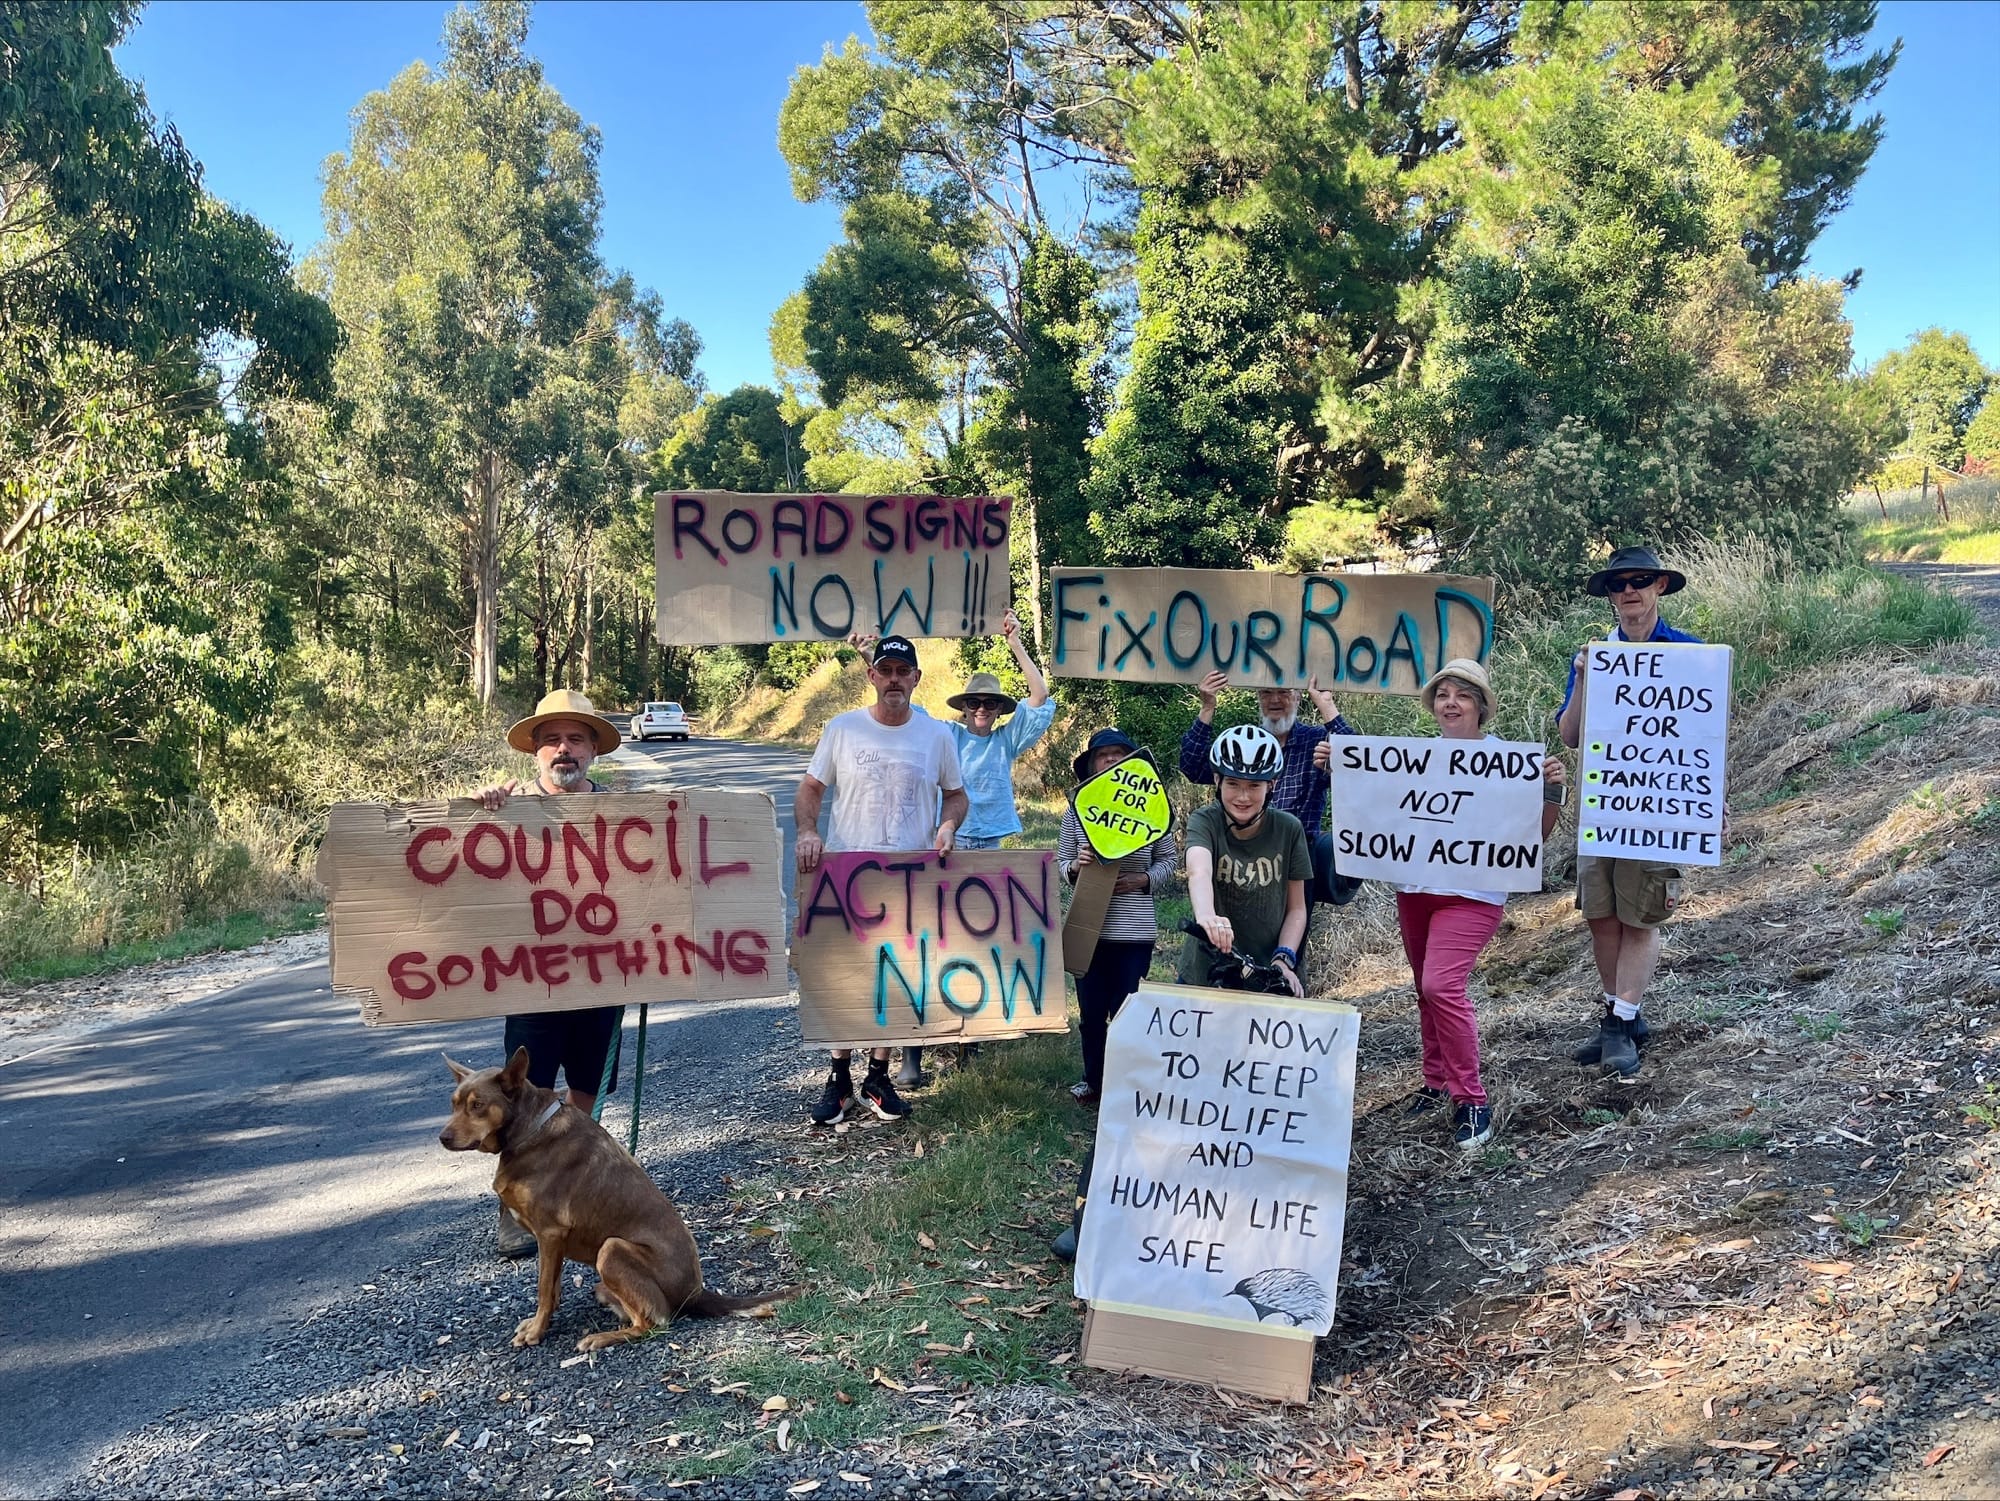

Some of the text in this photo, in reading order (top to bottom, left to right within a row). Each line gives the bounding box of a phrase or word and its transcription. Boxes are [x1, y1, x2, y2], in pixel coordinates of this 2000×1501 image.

[672, 496, 1012, 565] ROAD SIGNS
[769, 555, 935, 637] NOW
[1592, 651, 1664, 678] SAFE
[1615, 684, 1713, 713] ROADS
[1626, 715, 1680, 738] FOR
[1343, 746, 1543, 781] SLOW ROADS
[1606, 743, 1710, 769] LOCALS
[1110, 768, 1162, 795] SIGNS
[1600, 770, 1712, 795] TANKERS
[1113, 789, 1147, 812] FOR
[1399, 790, 1474, 816] NOT
[1598, 795, 1714, 819] TOURISTS
[1085, 806, 1161, 841] SAFETY
[1596, 826, 1717, 854] WILDLIFE
[1339, 829, 1539, 868] SLOW ACTION
[530, 889, 619, 938] DO
[875, 929, 1047, 1027] NOW
[1147, 1007, 1338, 1055] ACT NOW
[1161, 1051, 1318, 1098] TO KEEP
[1135, 1091, 1308, 1144] WILDLIFE
[1187, 1141, 1254, 1168] AND
[1111, 1175, 1318, 1238] HUMAN LIFE
[1138, 1236, 1225, 1273] SAFE
